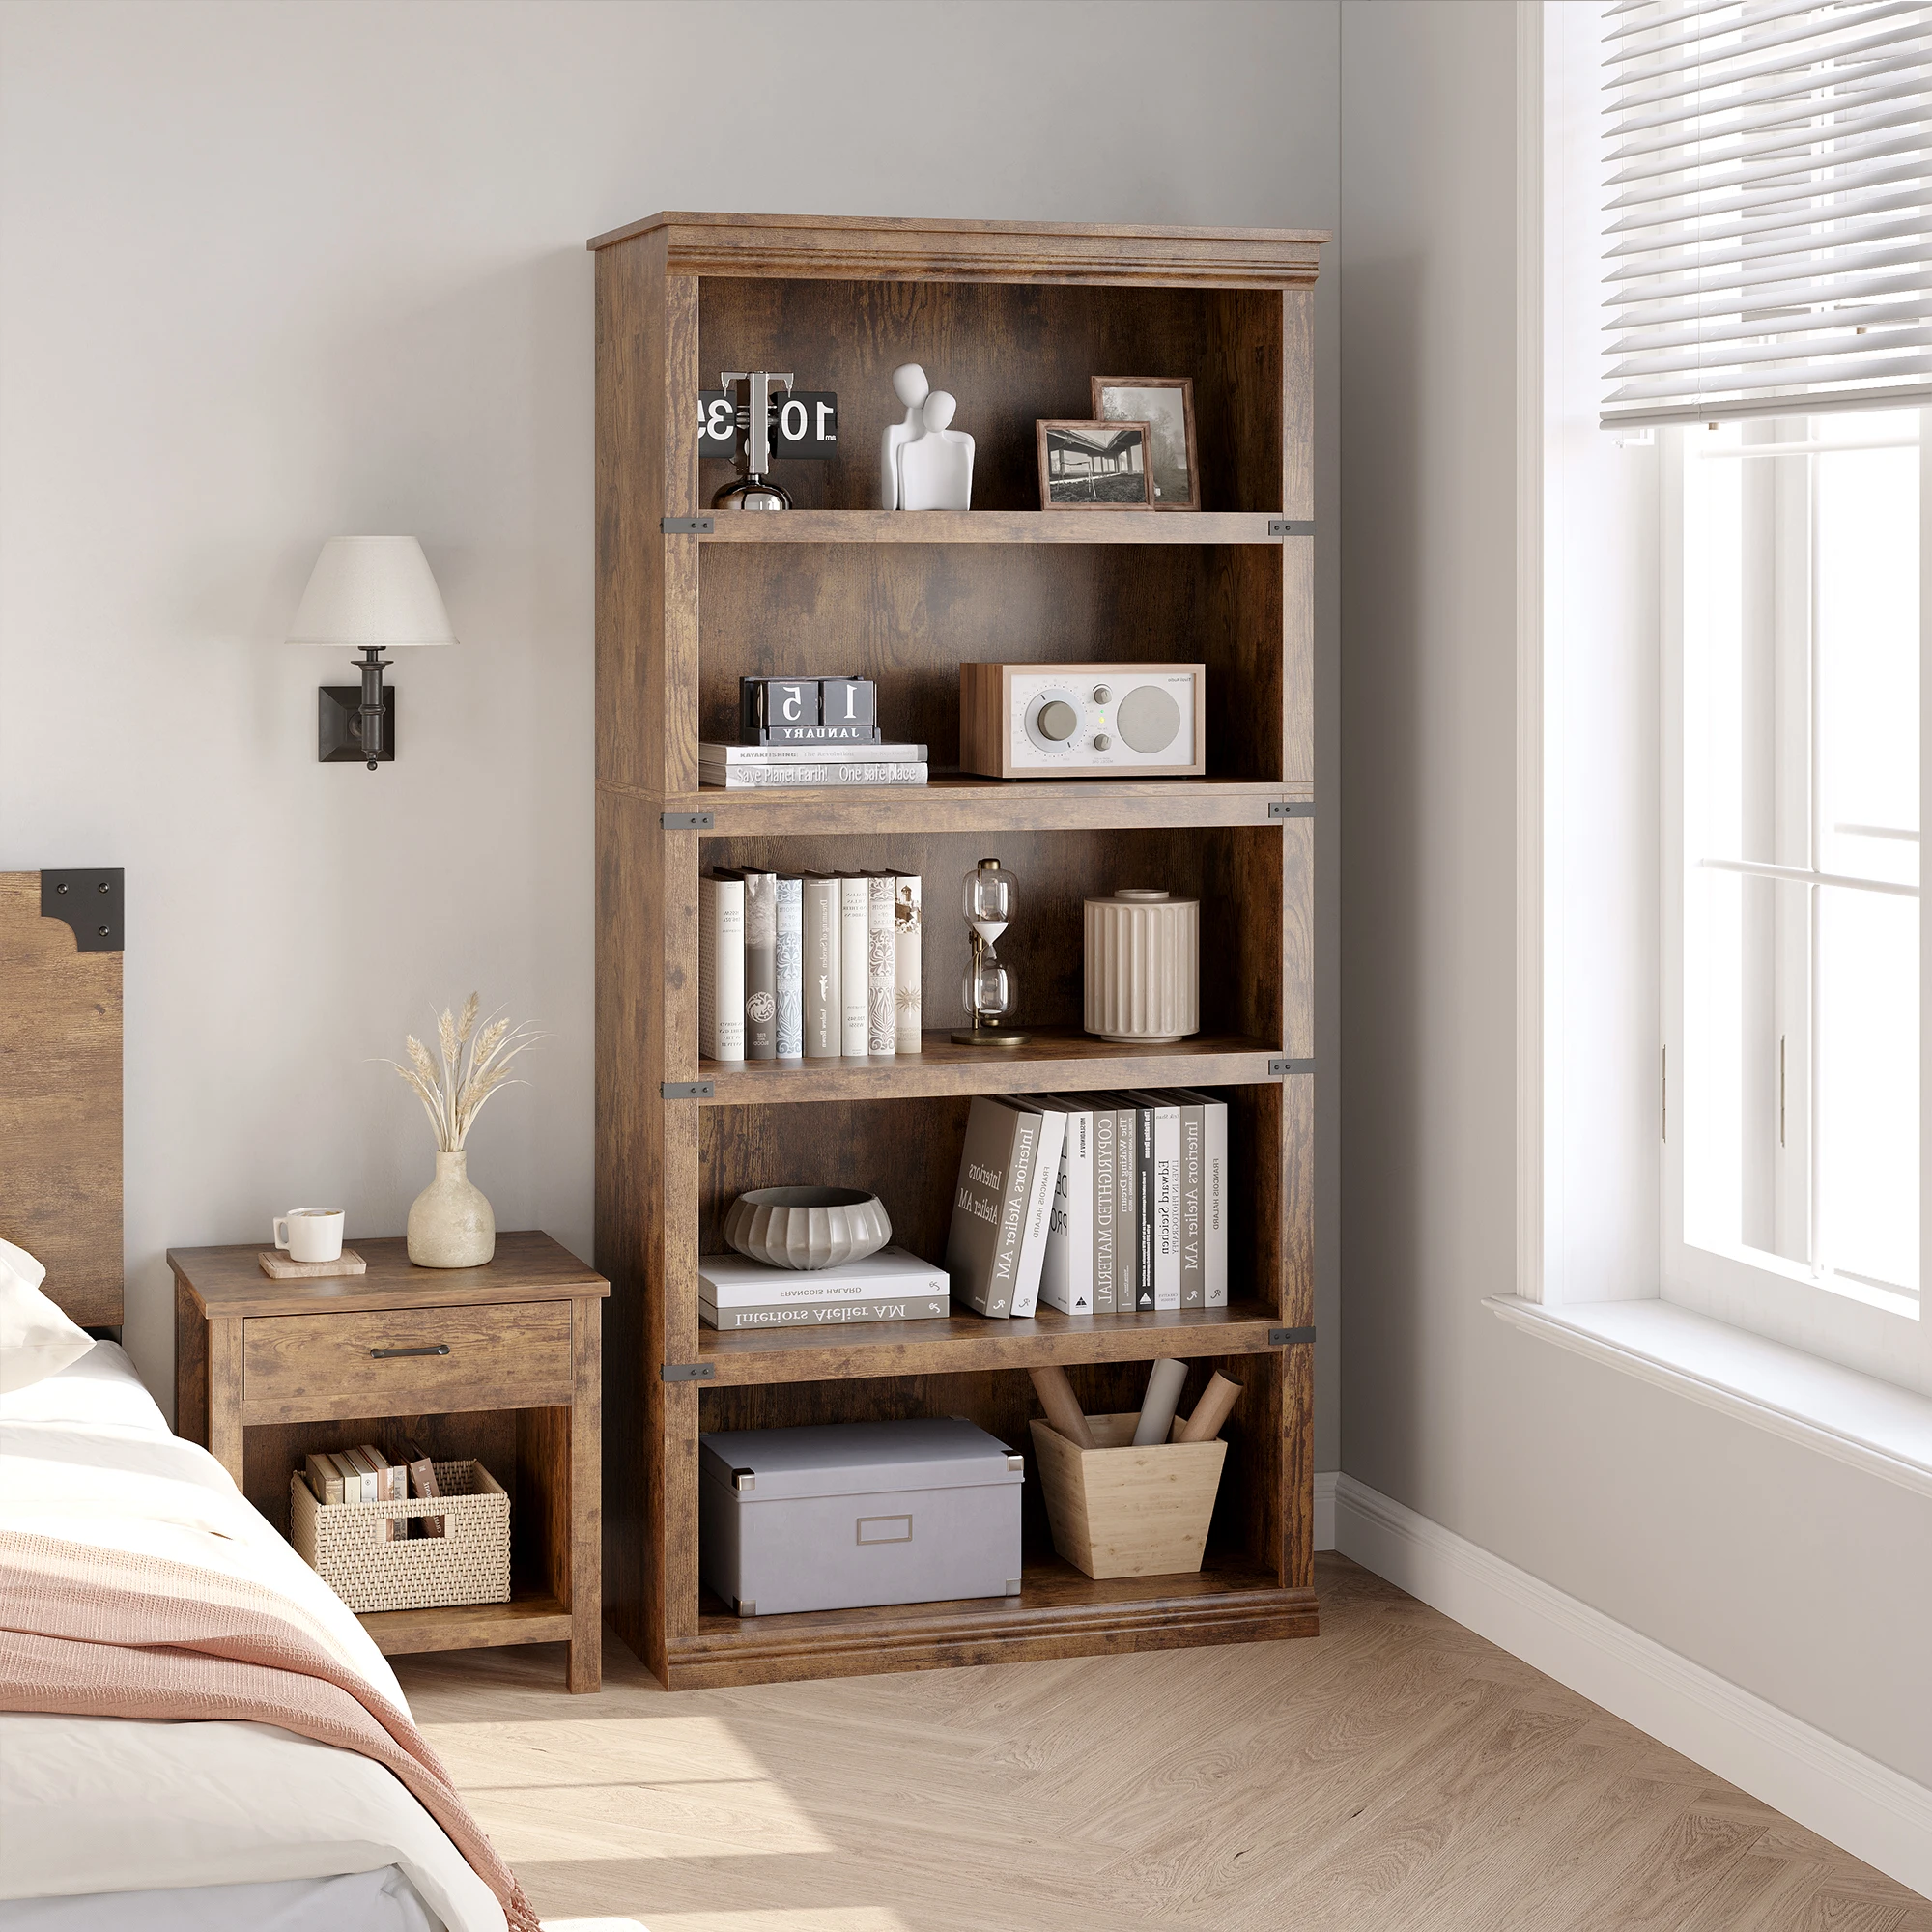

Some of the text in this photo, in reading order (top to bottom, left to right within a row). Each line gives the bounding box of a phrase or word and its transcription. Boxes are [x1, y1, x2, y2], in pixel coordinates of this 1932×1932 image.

[737, 764, 916, 784] Save Planet Earth! One safe place
